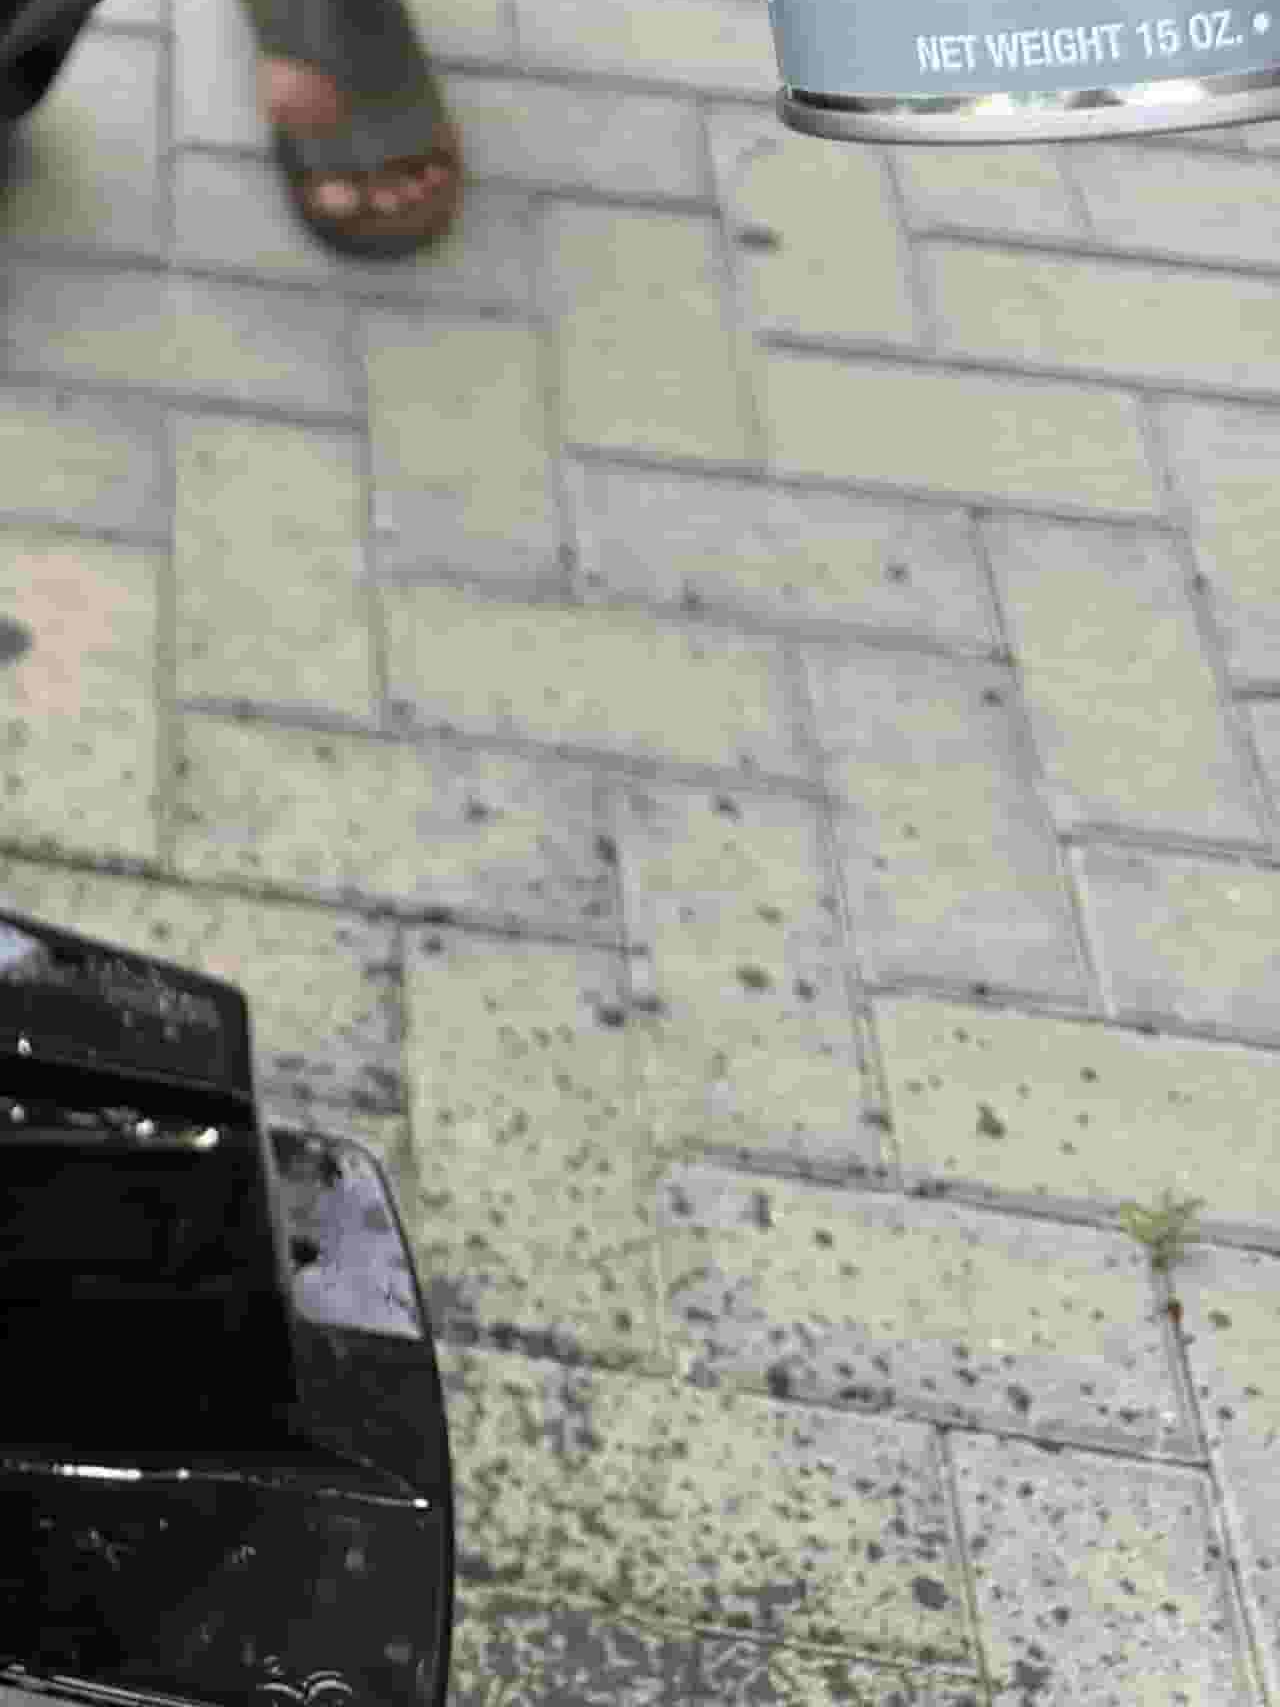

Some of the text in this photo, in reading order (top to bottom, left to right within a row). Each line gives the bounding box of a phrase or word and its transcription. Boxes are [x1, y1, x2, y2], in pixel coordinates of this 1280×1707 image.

[915, 8, 1244, 74] NET WEIGHT 15 OZ.
